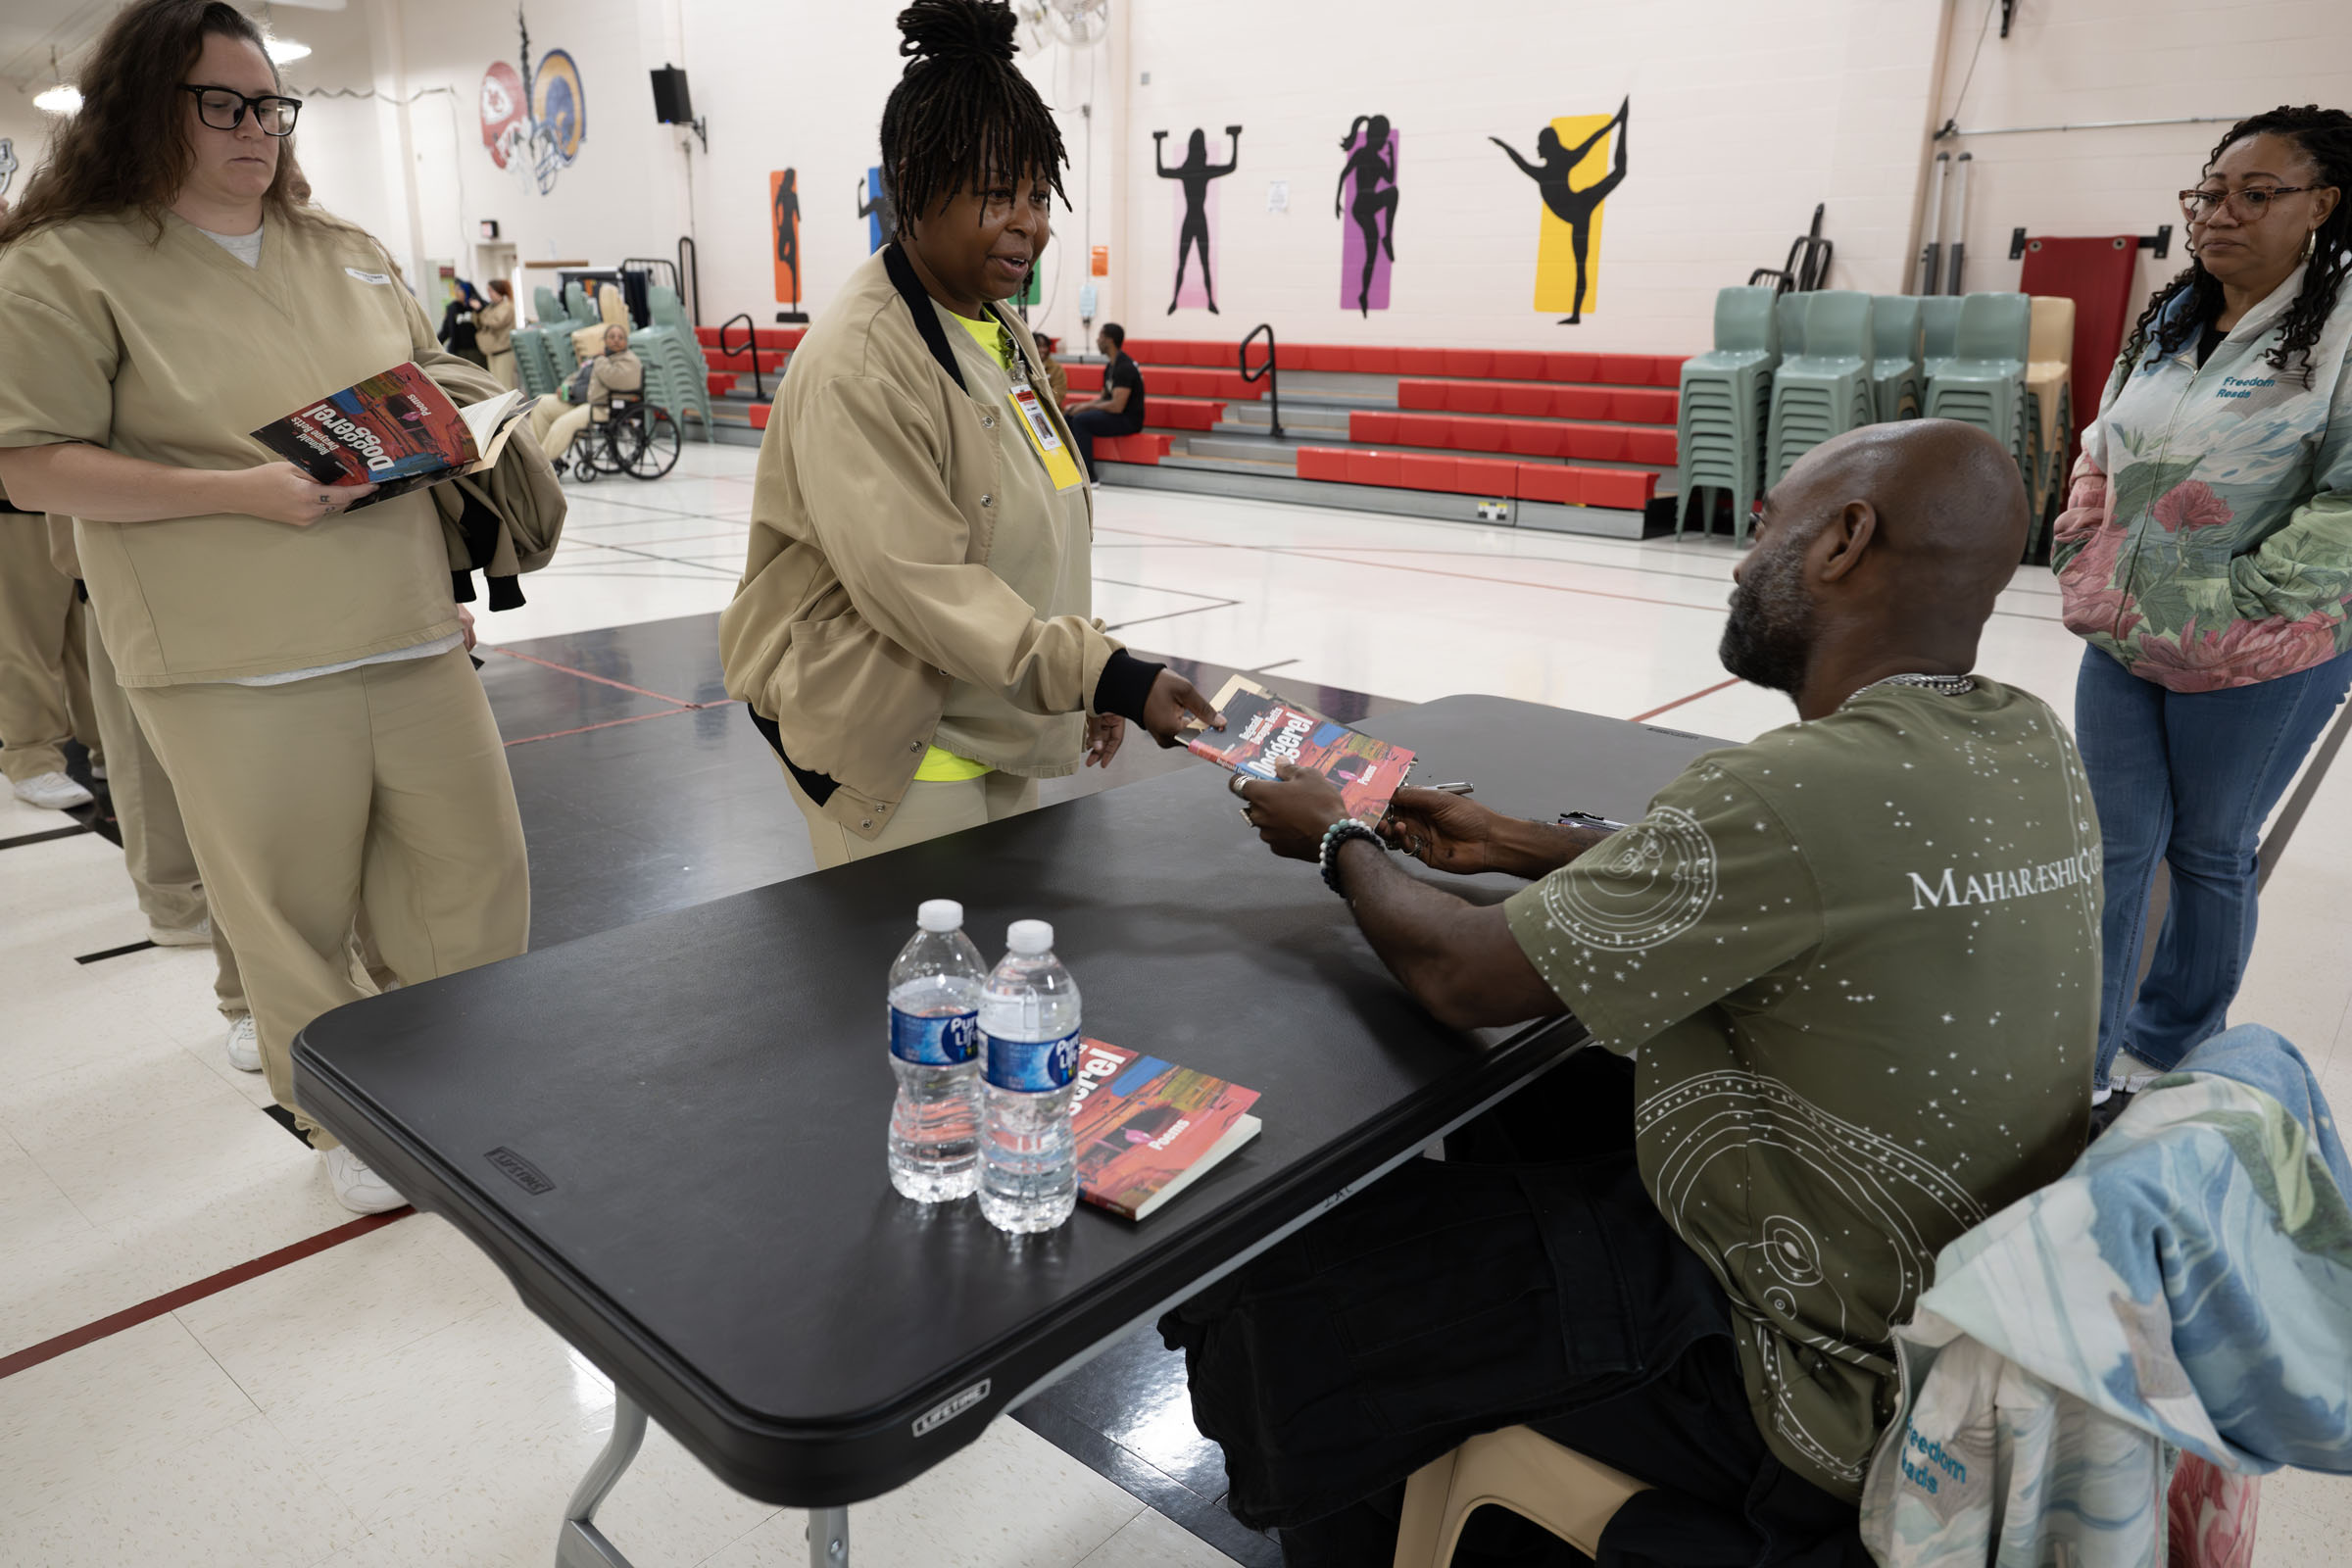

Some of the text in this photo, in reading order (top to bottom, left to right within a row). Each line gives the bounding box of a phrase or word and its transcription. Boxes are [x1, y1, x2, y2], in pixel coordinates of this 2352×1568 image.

[2224, 375, 2276, 388] Freedom
[2216, 389, 2251, 398] Reads
[407, 394, 431, 416] Poems
[296, 433, 331, 456] Reginald
[301, 404, 395, 472] Doggerel
[1148, 1119, 1190, 1151] Poems
